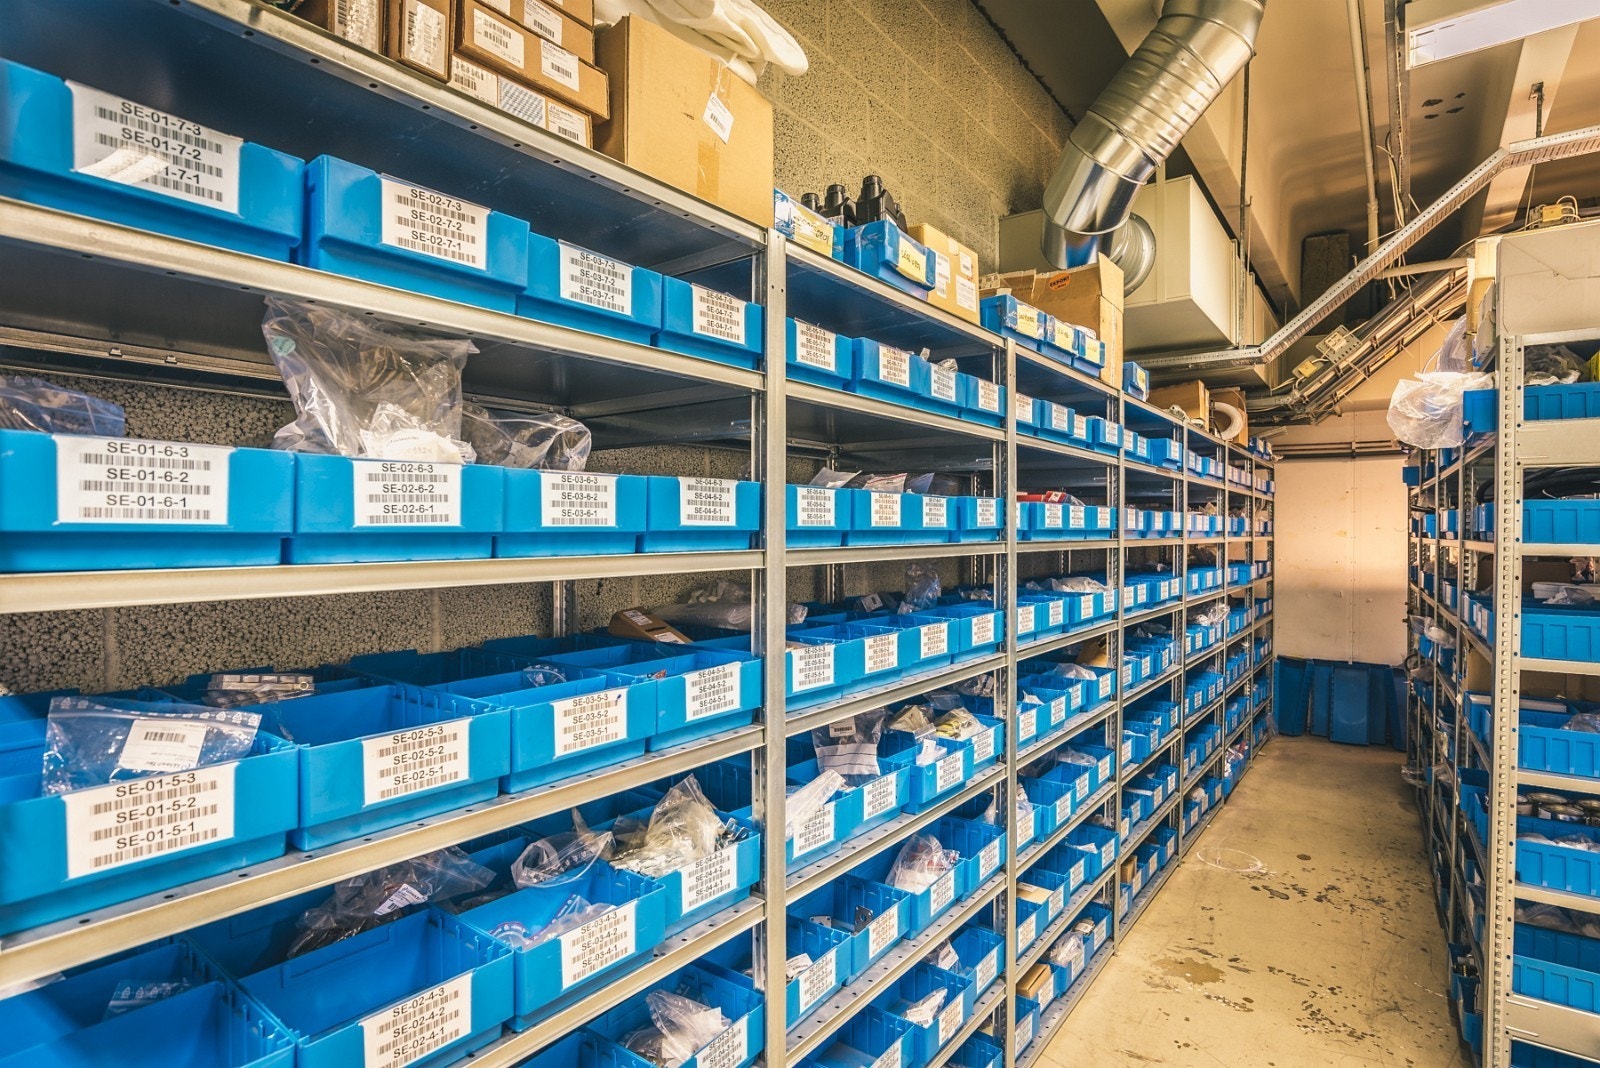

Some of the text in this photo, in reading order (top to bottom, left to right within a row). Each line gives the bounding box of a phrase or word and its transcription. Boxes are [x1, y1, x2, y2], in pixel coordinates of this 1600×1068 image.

[122, 102, 201, 136] SE-01-7-3
[122, 128, 201, 160] SE-01-7-2
[411, 189, 462, 211] SE-02-7-3
[411, 210, 462, 231] SE-02-7-2
[412, 230, 461, 250] SE-02-7-1
[580, 252, 616, 270] SE-03-7-3
[580, 269, 615, 286] SE-03-7-2
[580, 286, 614, 302] SE-03-7-1
[707, 291, 733, 304] SE-04-7-3
[707, 306, 733, 318] SE-04-7-2
[707, 320, 732, 332] SE-04-7-1
[107, 442, 188, 458] SE-01-6-3
[107, 468, 188, 483] SE-01-6-2
[382, 463, 433, 473] SE-02-6-3
[561, 475, 598, 484] SE-03-6-3
[695, 478, 722, 486] SE-04-6-3
[382, 484, 434, 493] SE-02-6-2
[562, 492, 598, 500] SE-03-6-2
[695, 492, 722, 501] SE-04-6-2
[107, 494, 186, 508] SE-01-6-1
[383, 505, 434, 513] SE-02-6-1
[562, 509, 597, 517] SE-03-6-1
[698, 666, 725, 678] SE-04-5-3
[699, 681, 726, 693] SE-04-5-2
[573, 693, 608, 707] SE-03-5-3
[699, 695, 726, 708] SE-04-5-1
[573, 710, 608, 724] SE-03-5-2
[393, 726, 444, 744] SE-02-5-3
[573, 727, 608, 741] SE-03-5-1
[394, 745, 444, 765] SE-02-5-2
[394, 766, 444, 785] SE-02-5-1
[117, 772, 196, 797] SE-01-5-3
[117, 797, 196, 823] SE-01-5-2
[117, 822, 194, 849] SE-01-5-1
[695, 852, 723, 868] SE-04-4-3
[695, 866, 723, 882] SE-04-4-2
[696, 880, 723, 897] SE-04-4-1
[581, 912, 618, 934] SE-03-4-3
[581, 928, 618, 951] SE-03-4-2
[582, 944, 618, 968] SE-03-4-1
[393, 987, 445, 1017] SE-02-4-3
[393, 1007, 445, 1038] SE-02-4-2
[394, 1027, 445, 1058] SE-02-4-1
